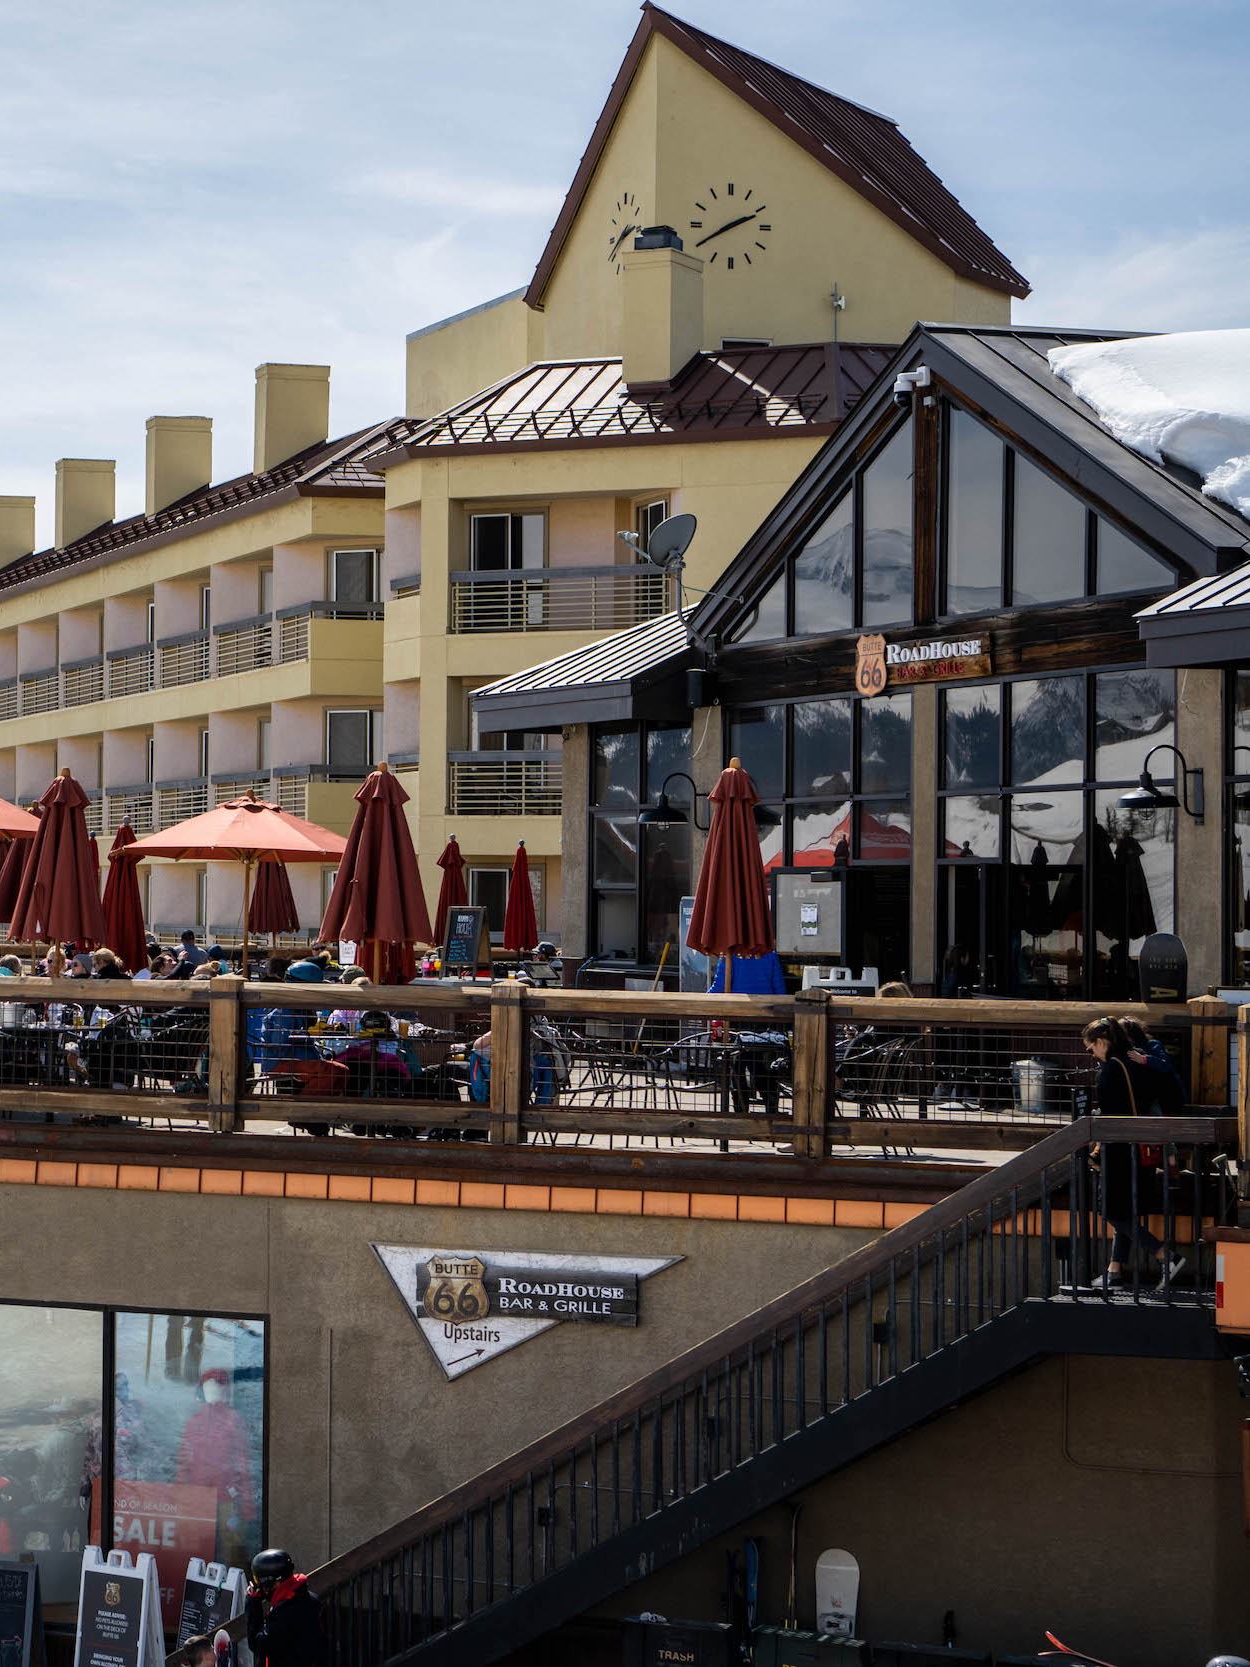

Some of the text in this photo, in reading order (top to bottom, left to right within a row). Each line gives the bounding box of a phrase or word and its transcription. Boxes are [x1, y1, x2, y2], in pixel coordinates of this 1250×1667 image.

[862, 641, 882, 652] BUTTE
[860, 658, 882, 688] 66
[896, 661, 965, 679] BAR & GRILLE
[434, 1263, 479, 1275] BUTTE
[433, 1282, 480, 1316] 66
[499, 1297, 611, 1314] BAR & GRILLE
[444, 1323, 500, 1343] Upstairs
[114, 1515, 175, 1547] SALE
[106, 1590, 119, 1603] 66
[658, 1649, 695, 1662] TRASH
